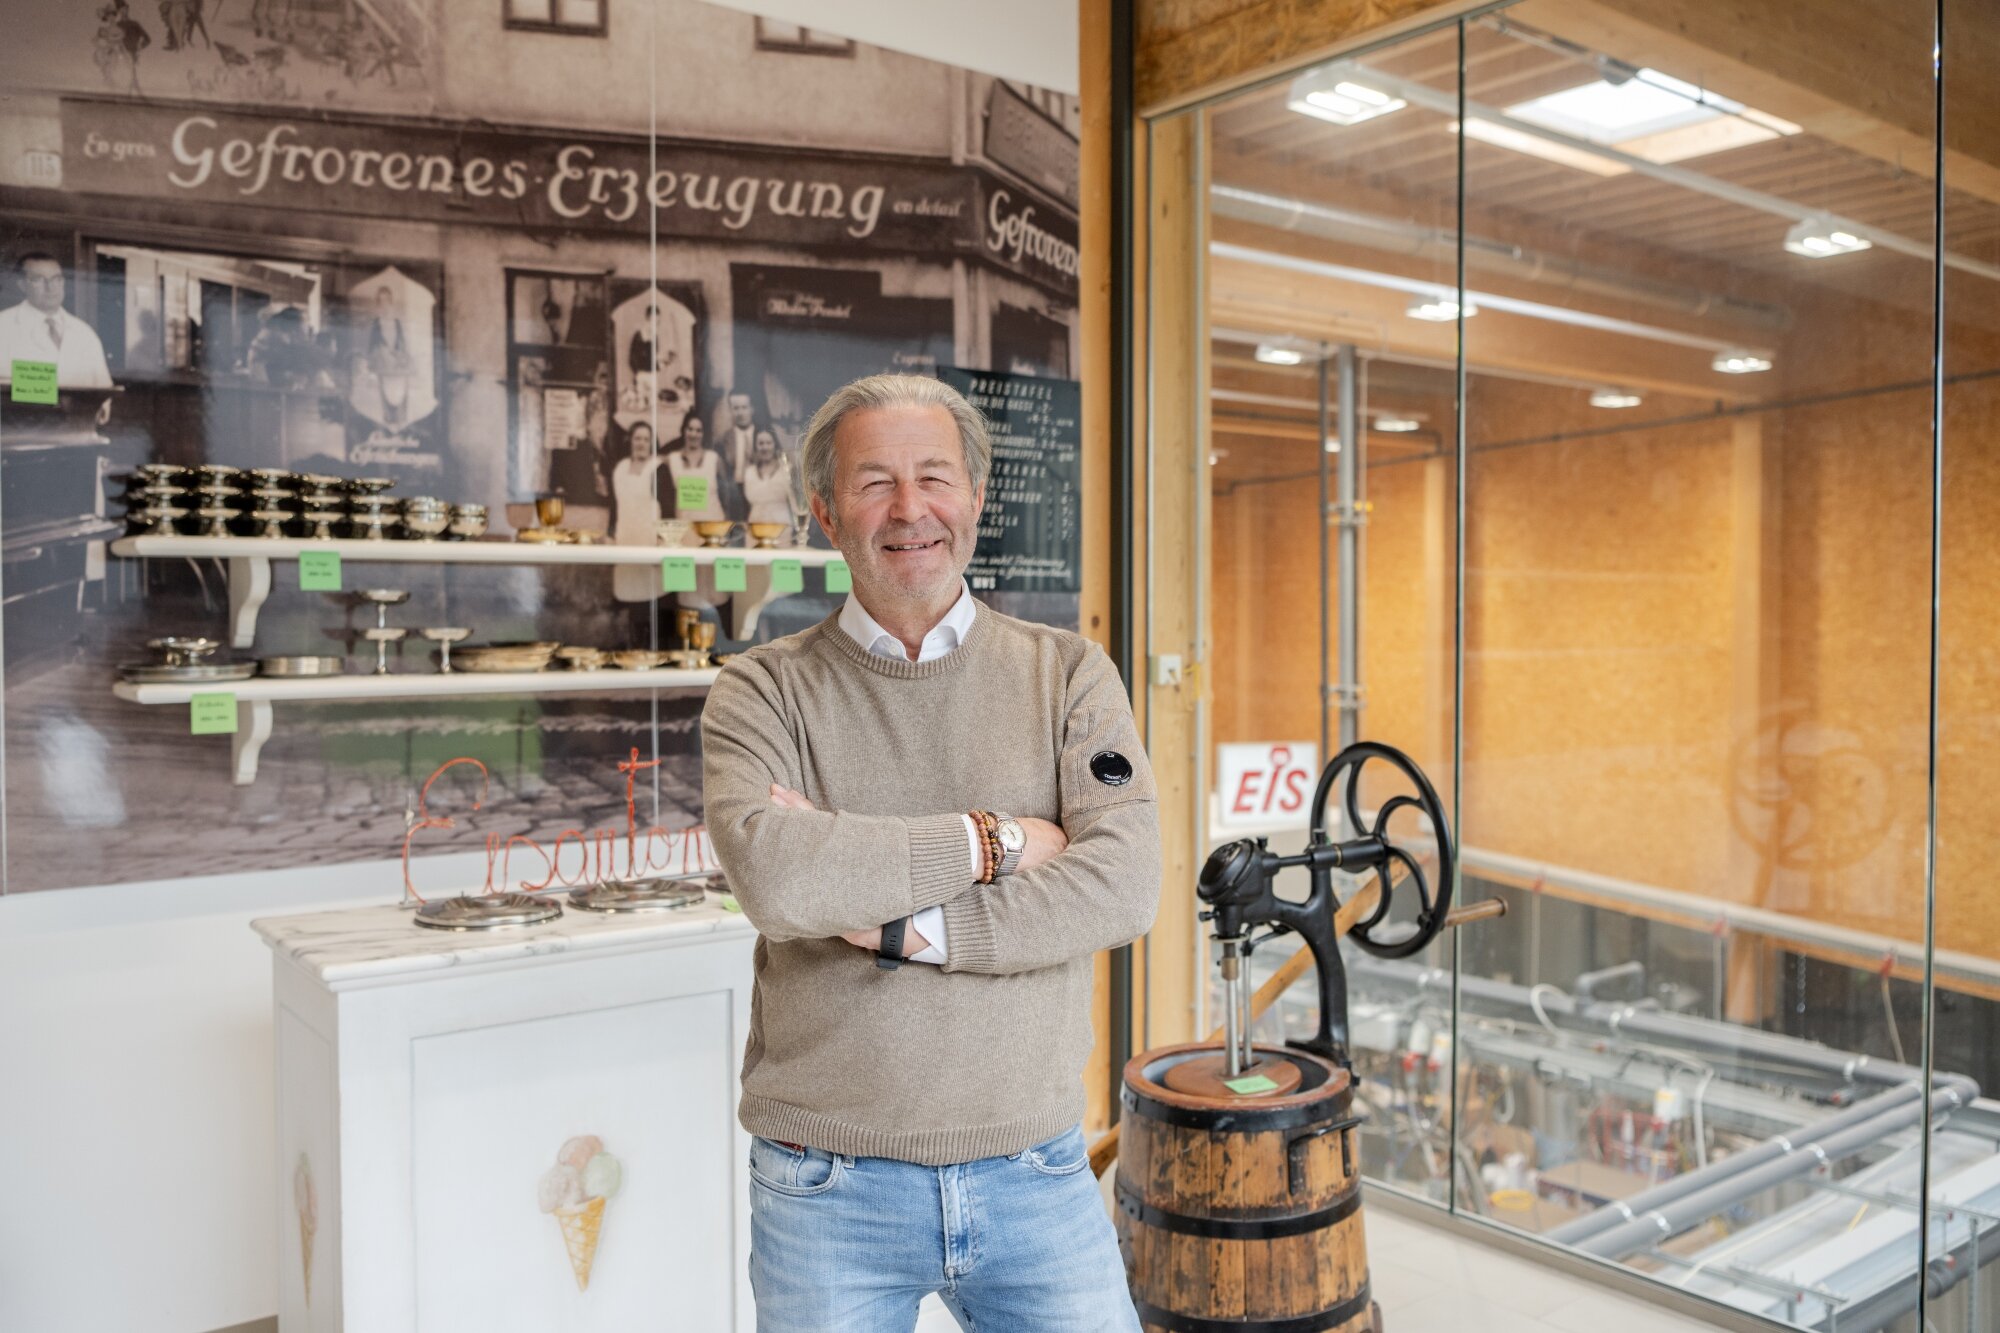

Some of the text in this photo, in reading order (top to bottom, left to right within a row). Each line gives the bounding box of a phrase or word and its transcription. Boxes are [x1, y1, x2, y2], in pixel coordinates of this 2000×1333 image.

[168, 116, 527, 197] Gefrorenes
[547, 145, 886, 240] Erzeugung
[988, 189, 1081, 279] Gefroren
[969, 378, 1053, 400] PREISTAFEL
[989, 477, 1026, 490] ASSER
